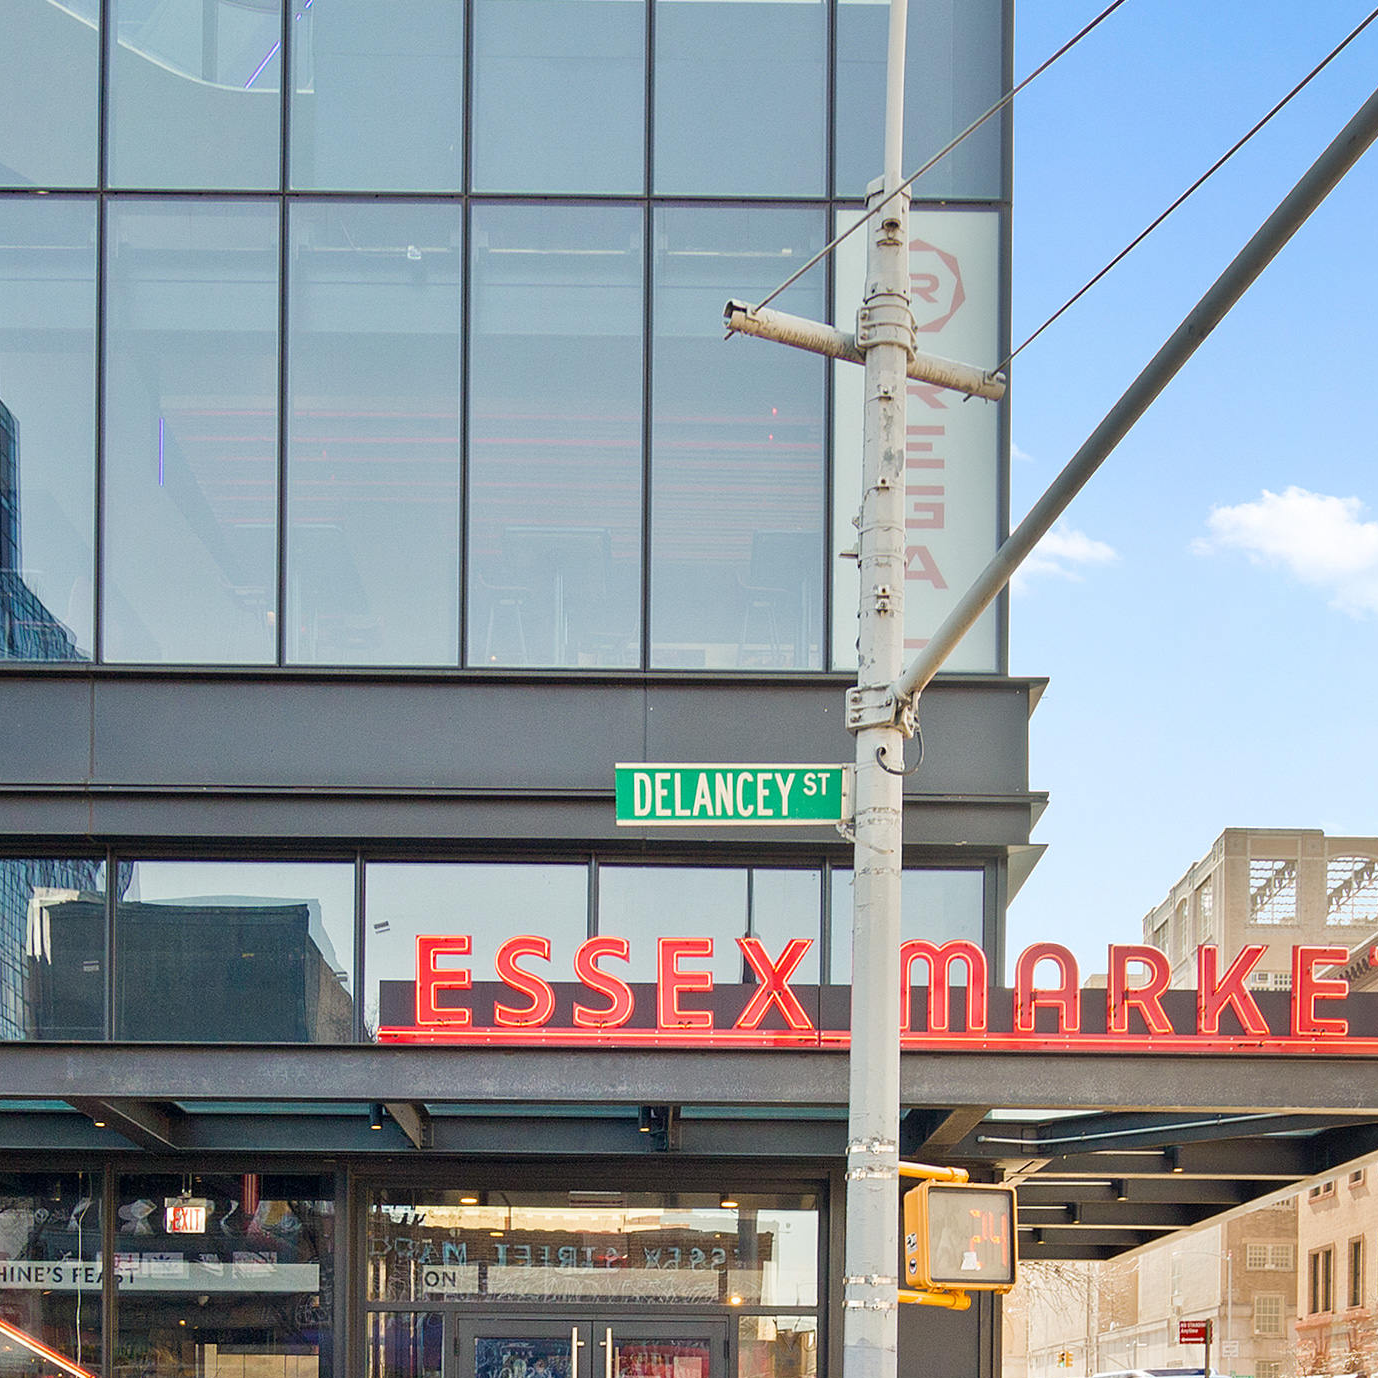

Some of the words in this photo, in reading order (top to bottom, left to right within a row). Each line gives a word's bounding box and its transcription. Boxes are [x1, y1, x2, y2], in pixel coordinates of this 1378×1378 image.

[633, 772, 796, 817] DELANCEY
[803, 772, 831, 796] ST
[415, 934, 814, 1030] ESSEX
[172, 1208, 201, 1231] EXIT
[969, 1208, 1008, 1267] 24
